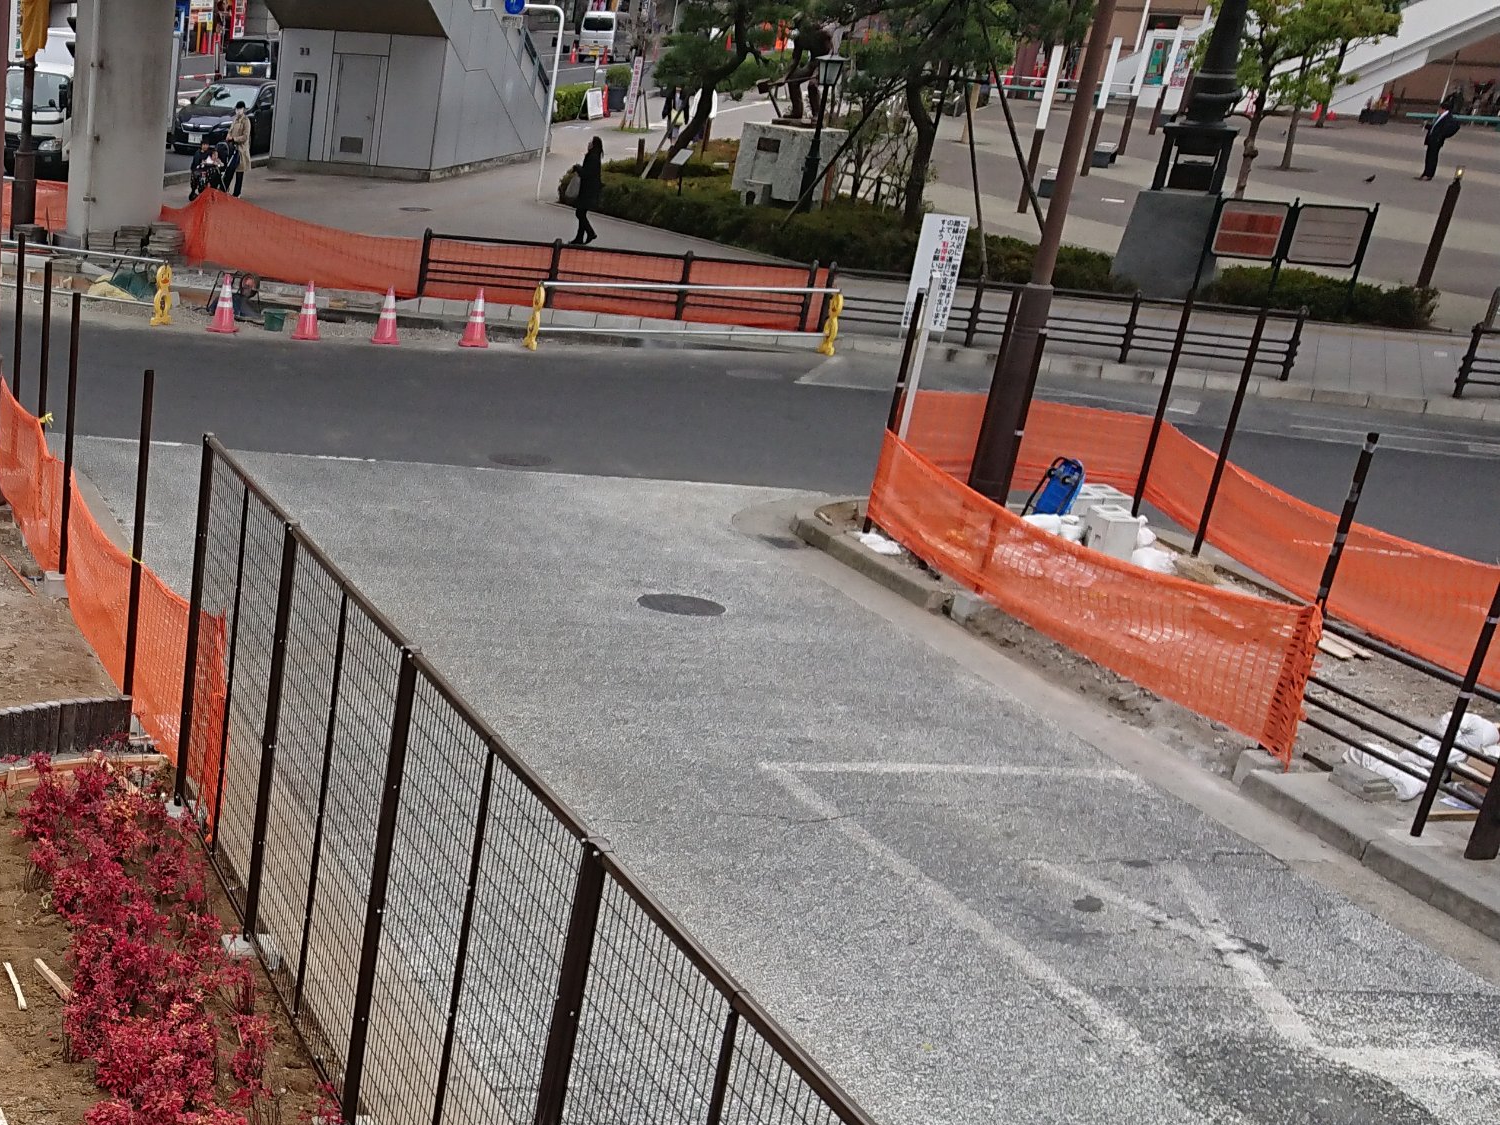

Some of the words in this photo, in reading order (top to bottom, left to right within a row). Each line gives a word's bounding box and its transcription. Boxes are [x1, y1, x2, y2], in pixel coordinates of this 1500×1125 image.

[937, 219, 954, 272] ので、駐停車は
